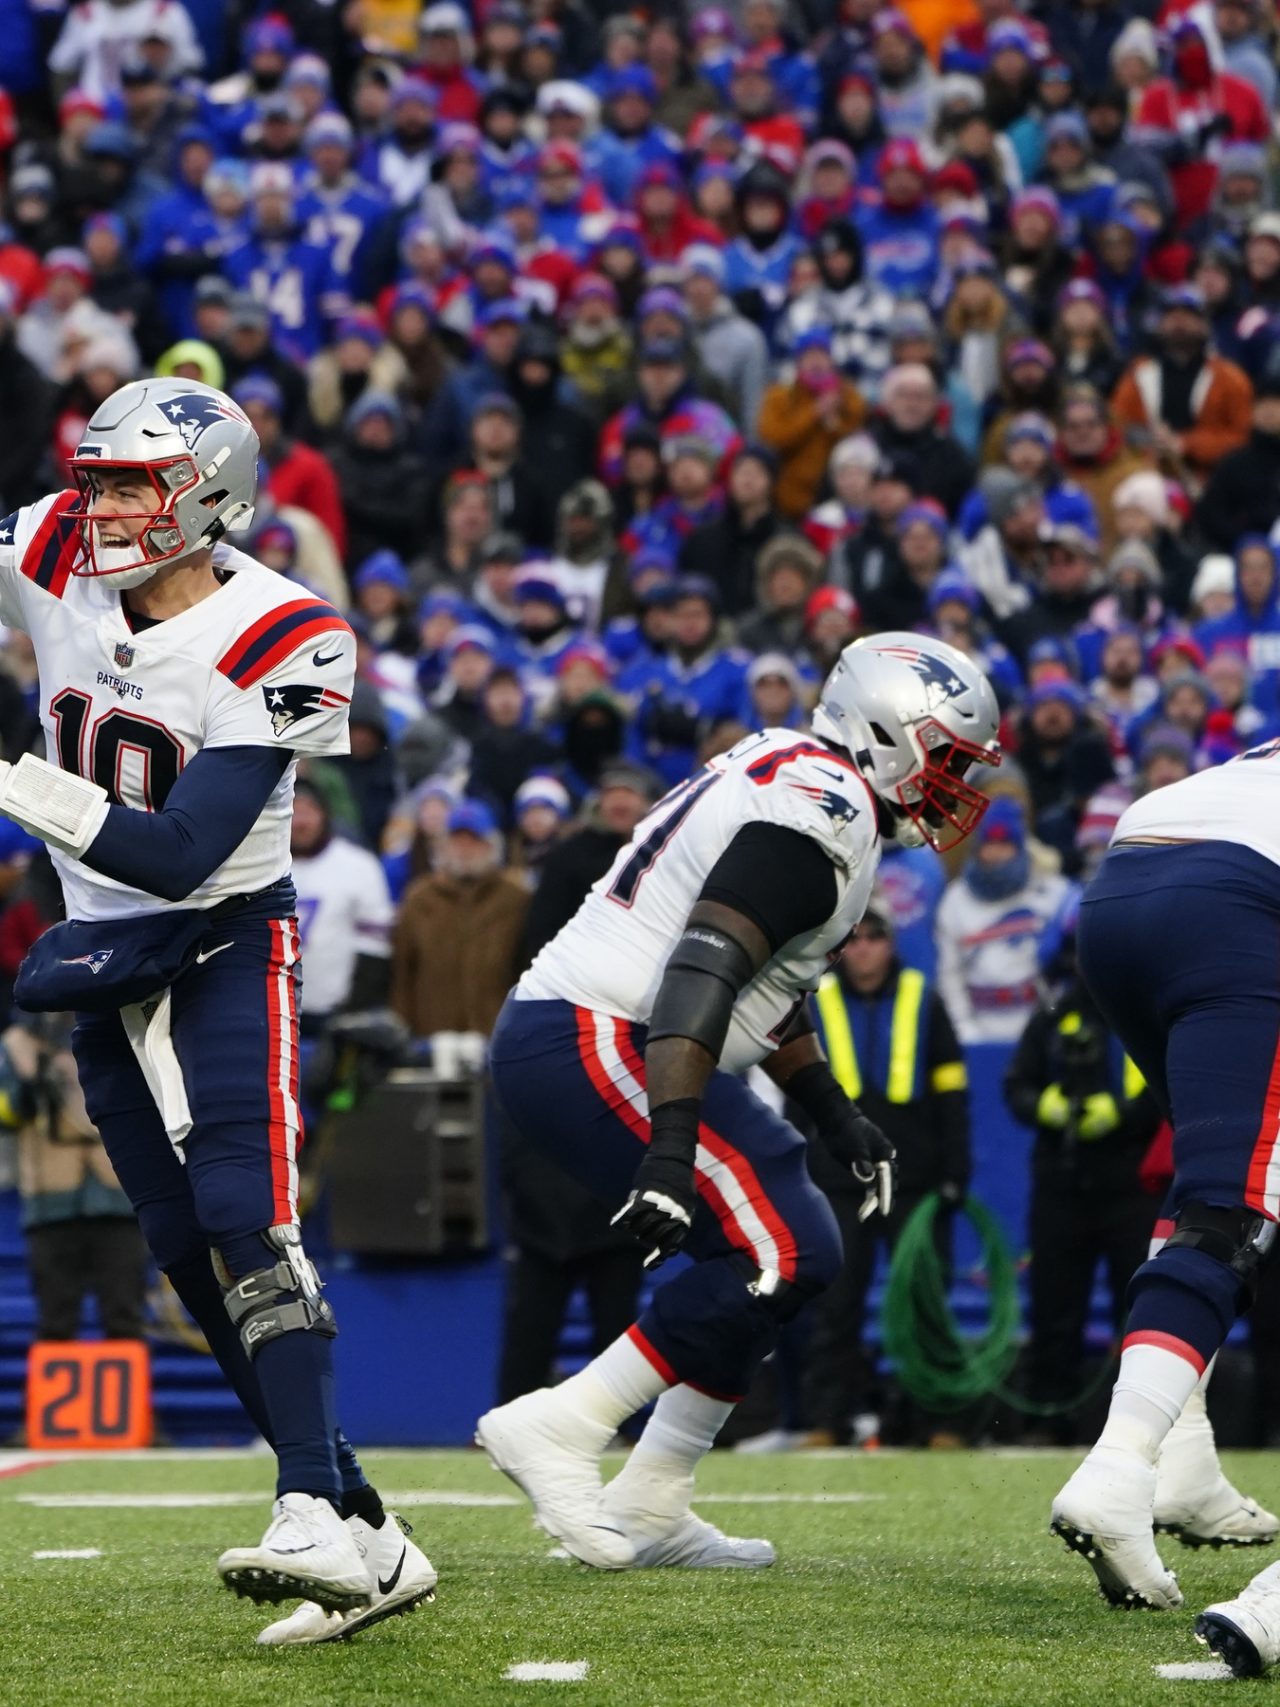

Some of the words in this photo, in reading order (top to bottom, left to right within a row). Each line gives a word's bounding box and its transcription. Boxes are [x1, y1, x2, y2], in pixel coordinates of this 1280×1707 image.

[250, 268, 303, 329] 14
[96, 671, 144, 700] PATRIOTS
[115, 653, 130, 667] NFL
[49, 686, 185, 814] 10
[43, 1358, 131, 1437] 20
